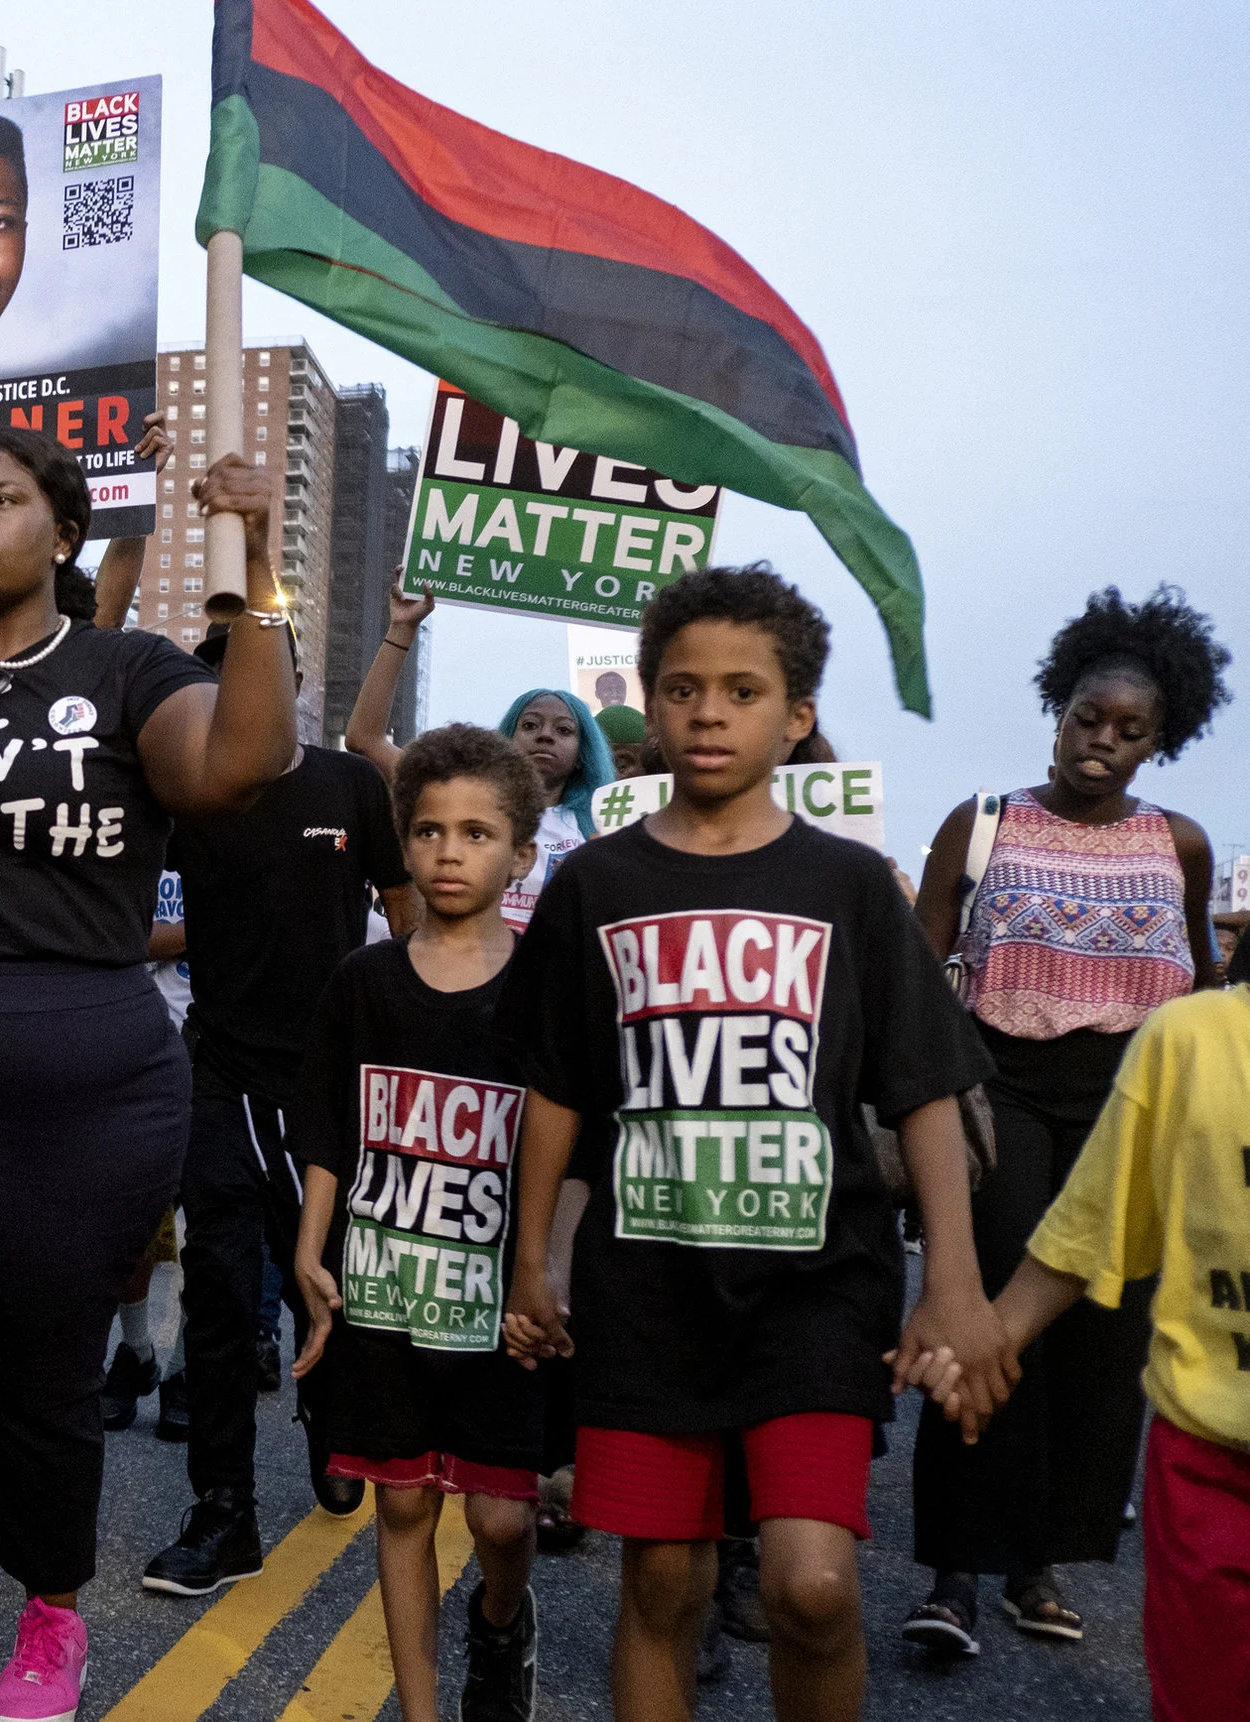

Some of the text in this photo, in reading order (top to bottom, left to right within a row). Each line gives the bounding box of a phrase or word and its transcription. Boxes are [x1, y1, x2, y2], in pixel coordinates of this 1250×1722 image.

[67, 93, 138, 122] BLACK
[66, 114, 138, 145] LIVES
[65, 136, 137, 160] MATTER
[65, 156, 93, 167] NEW
[102, 150, 136, 162] YORK
[41, 376, 71, 397] D.C.
[85, 453, 103, 469] TO
[106, 450, 135, 467] LIFE
[422, 487, 705, 574] MATTER
[418, 548, 657, 602] NEW YOR
[412, 576, 641, 620] WWW.BLACKLIVESMATTERGREATER
[611, 918, 823, 1015] BLACK
[623, 1015, 810, 1109] LIVES
[368, 1073, 517, 1163] BLACK
[351, 1151, 503, 1244] LIVES
[626, 1184, 818, 1219] NE YORK
[403, 1297, 490, 1330] YORK
